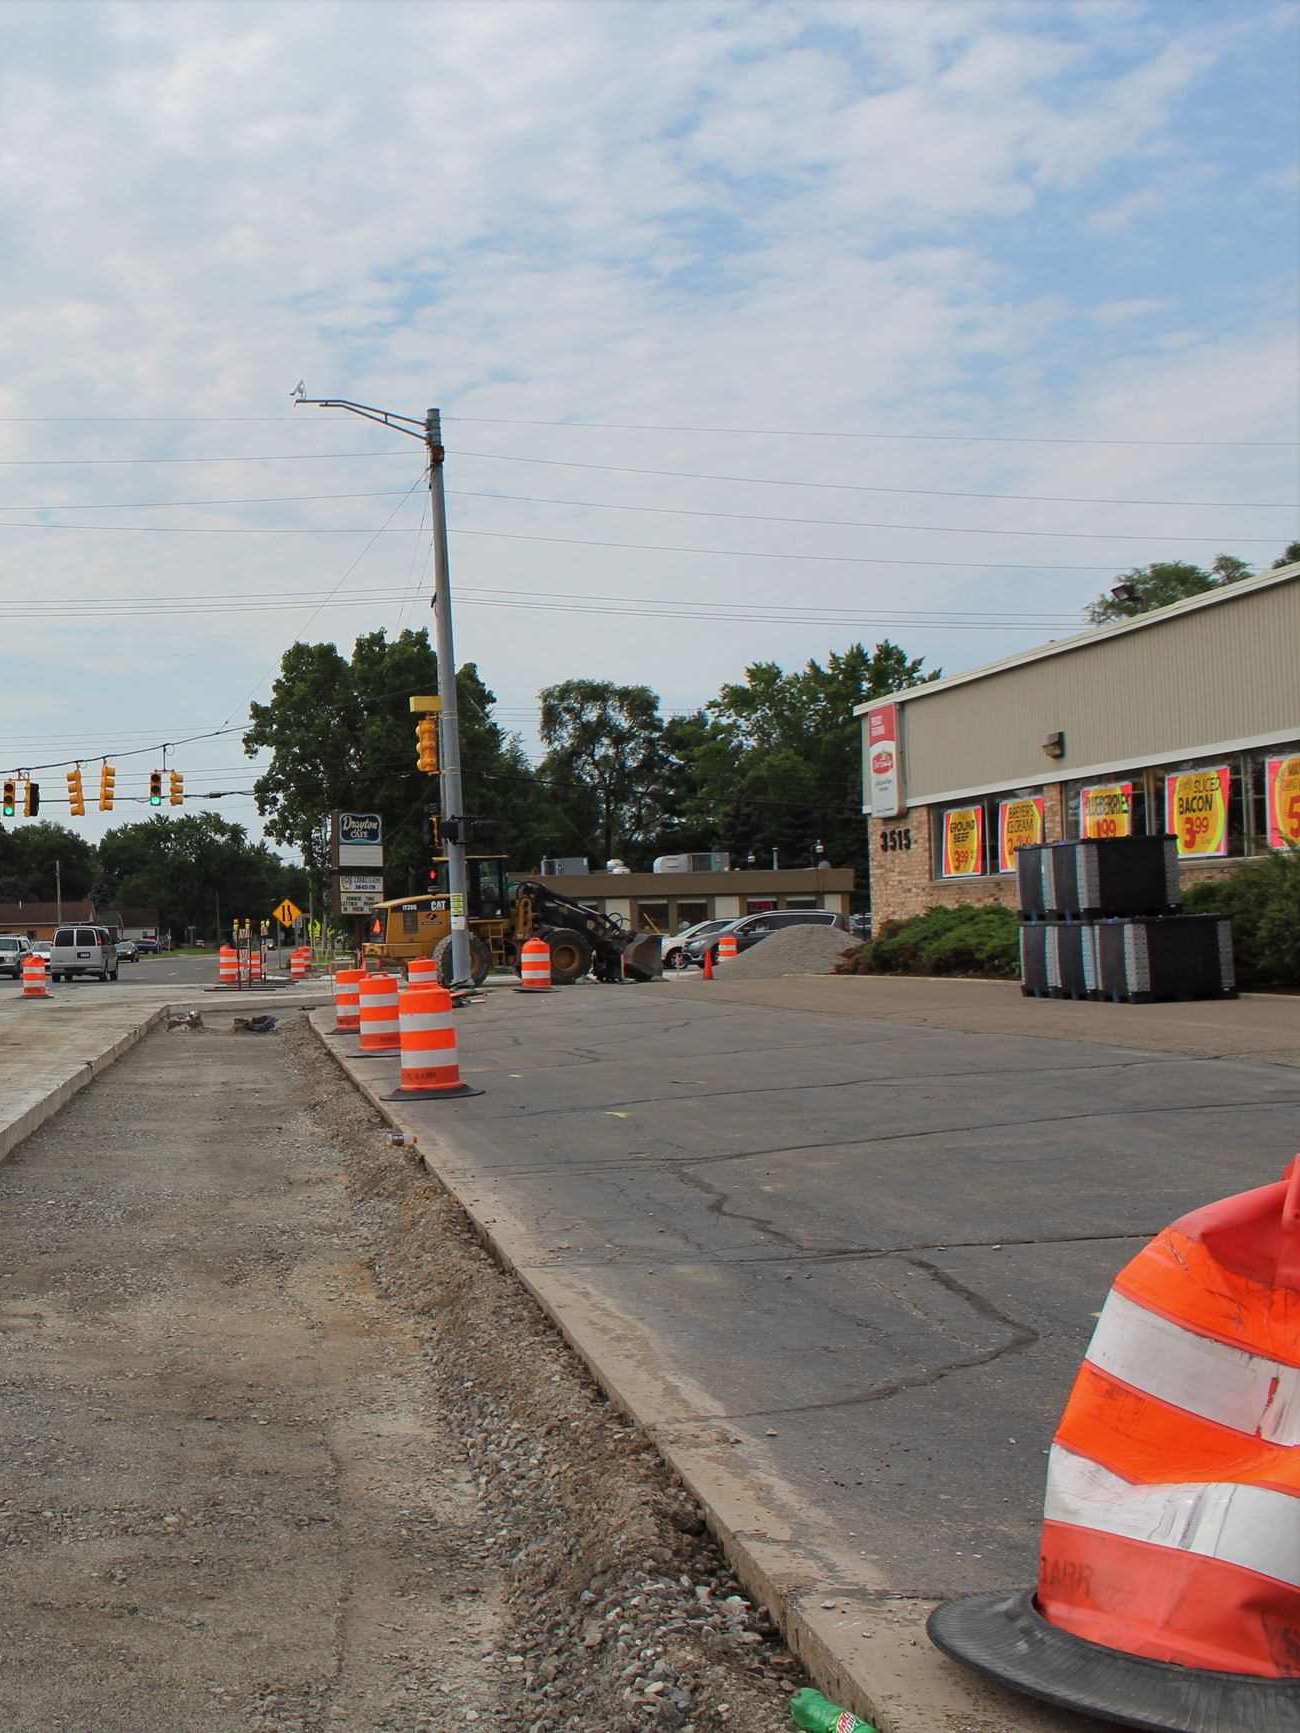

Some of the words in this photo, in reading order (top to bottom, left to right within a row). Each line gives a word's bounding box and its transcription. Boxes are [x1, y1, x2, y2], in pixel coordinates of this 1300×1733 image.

[1194, 777, 1220, 794] SLICED
[1179, 794, 1213, 815] BACON
[343, 816, 378, 831] Drayton
[950, 820, 975, 833] GROUND
[880, 829, 911, 852] 3515
[954, 832, 969, 843] BEEF
[431, 900, 446, 911] CAT
